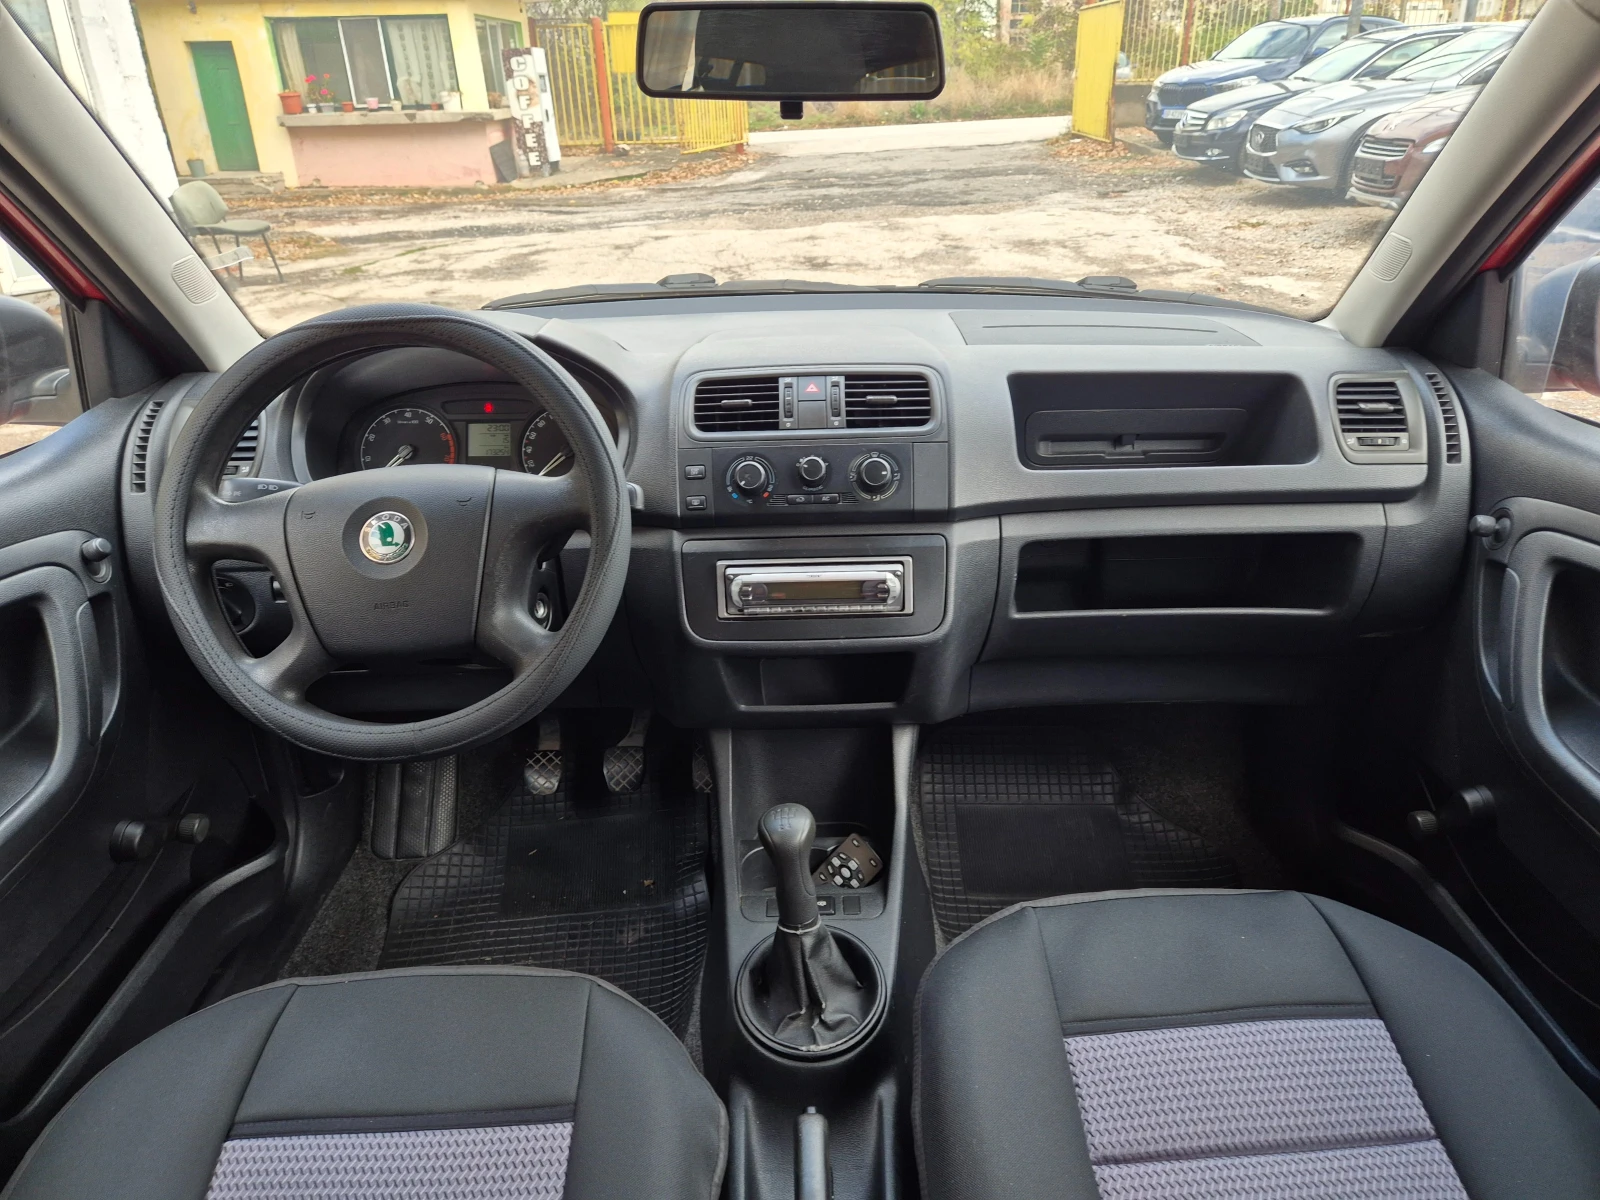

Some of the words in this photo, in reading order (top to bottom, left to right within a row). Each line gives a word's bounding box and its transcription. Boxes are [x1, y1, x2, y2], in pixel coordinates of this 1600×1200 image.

[510, 55, 542, 166] COFFEE
[382, 417, 391, 425] 30
[425, 416, 434, 425] 50
[373, 600, 410, 611] AIRBAG
